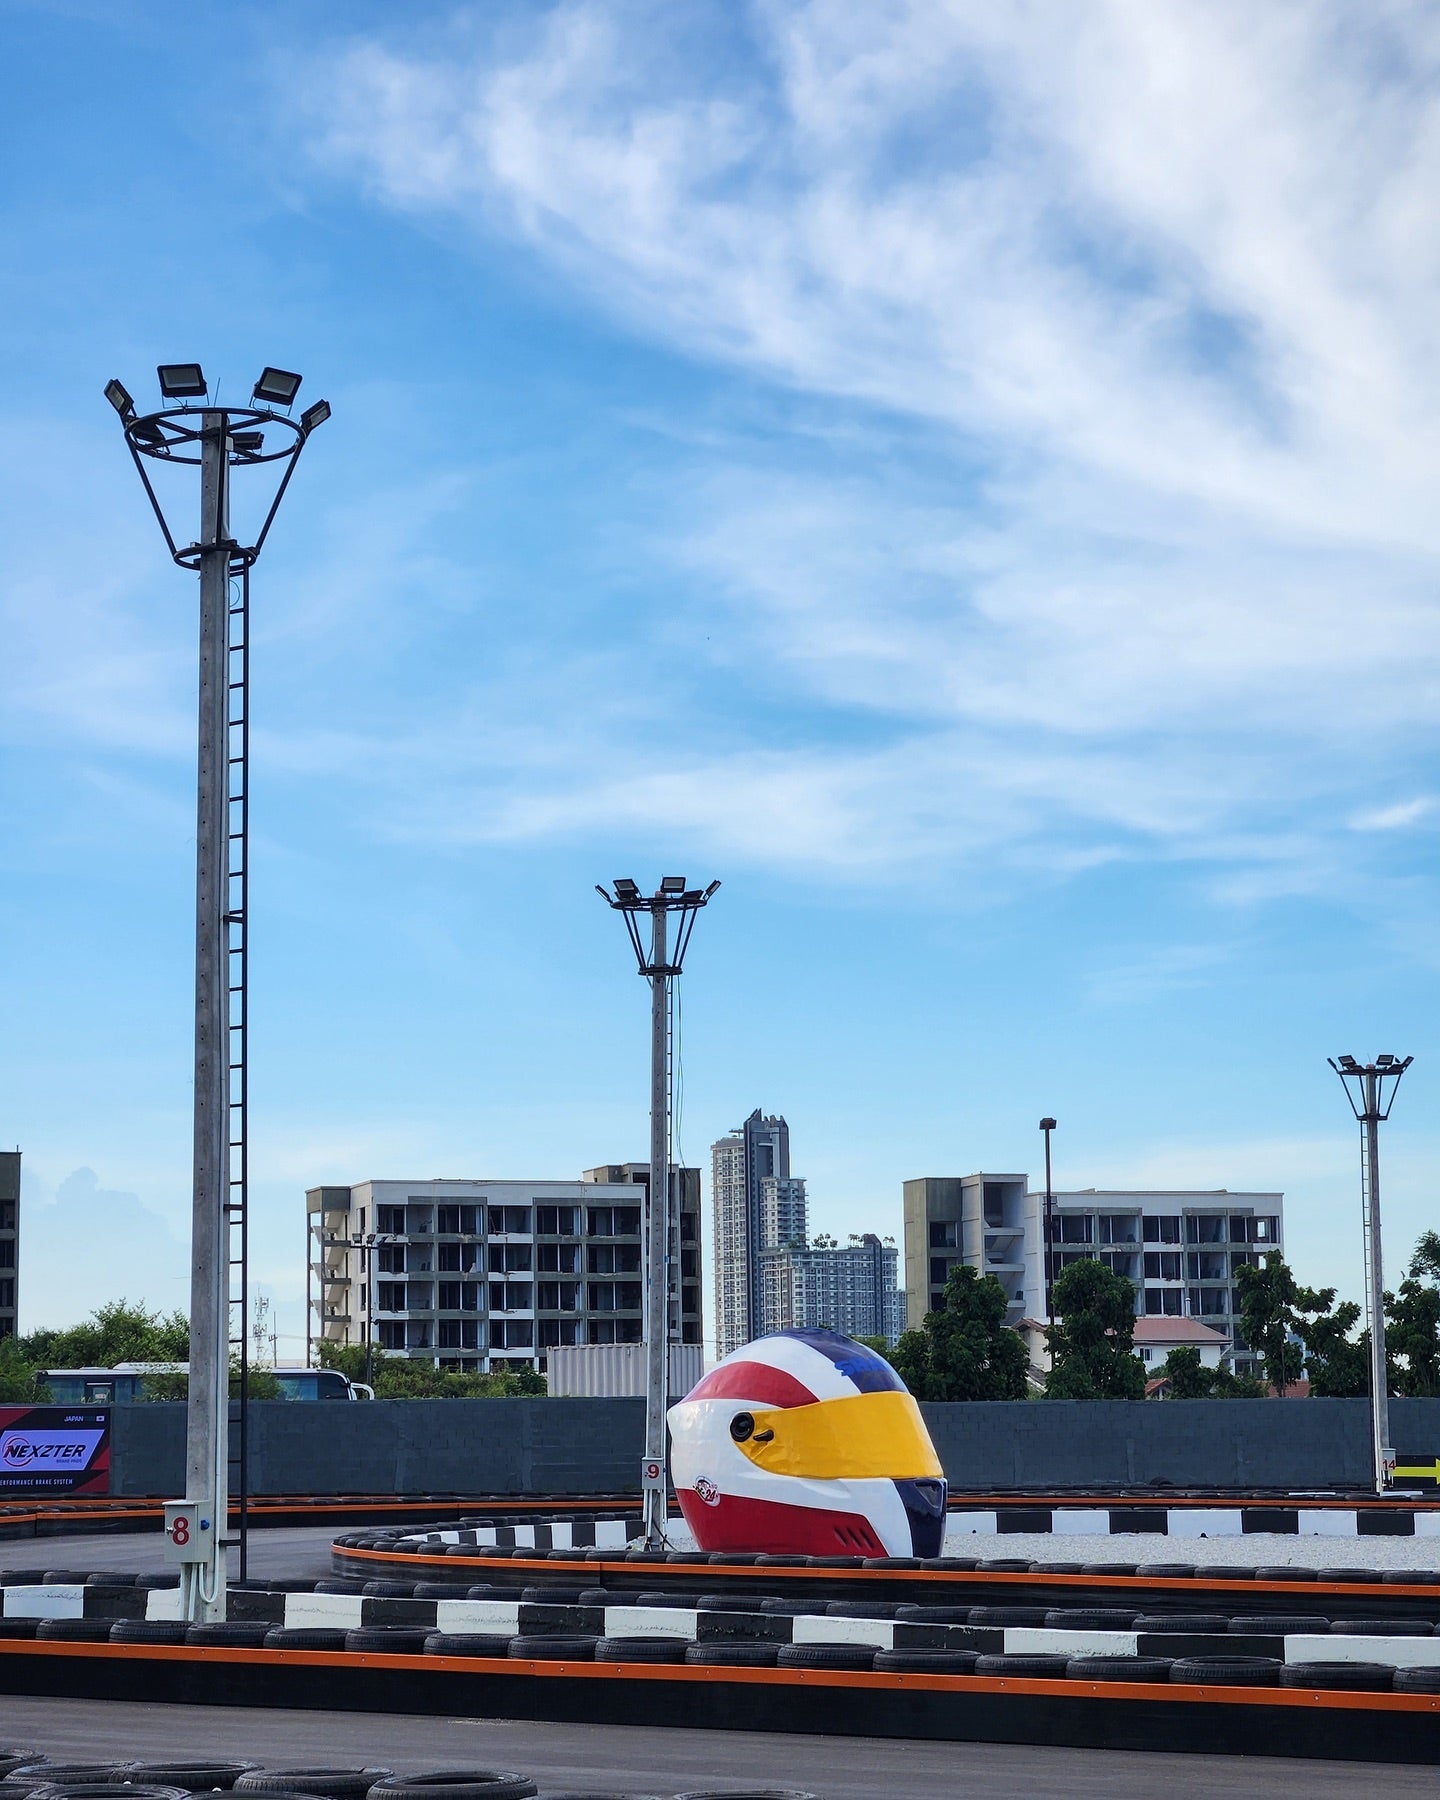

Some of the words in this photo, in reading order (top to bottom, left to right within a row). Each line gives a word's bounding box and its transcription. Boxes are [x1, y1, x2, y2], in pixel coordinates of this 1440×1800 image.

[3, 1444, 87, 1458] NEXZTER
[647, 1463, 660, 1479] 9
[1382, 1459, 1396, 1470] 14
[172, 1516, 190, 1546] 8
